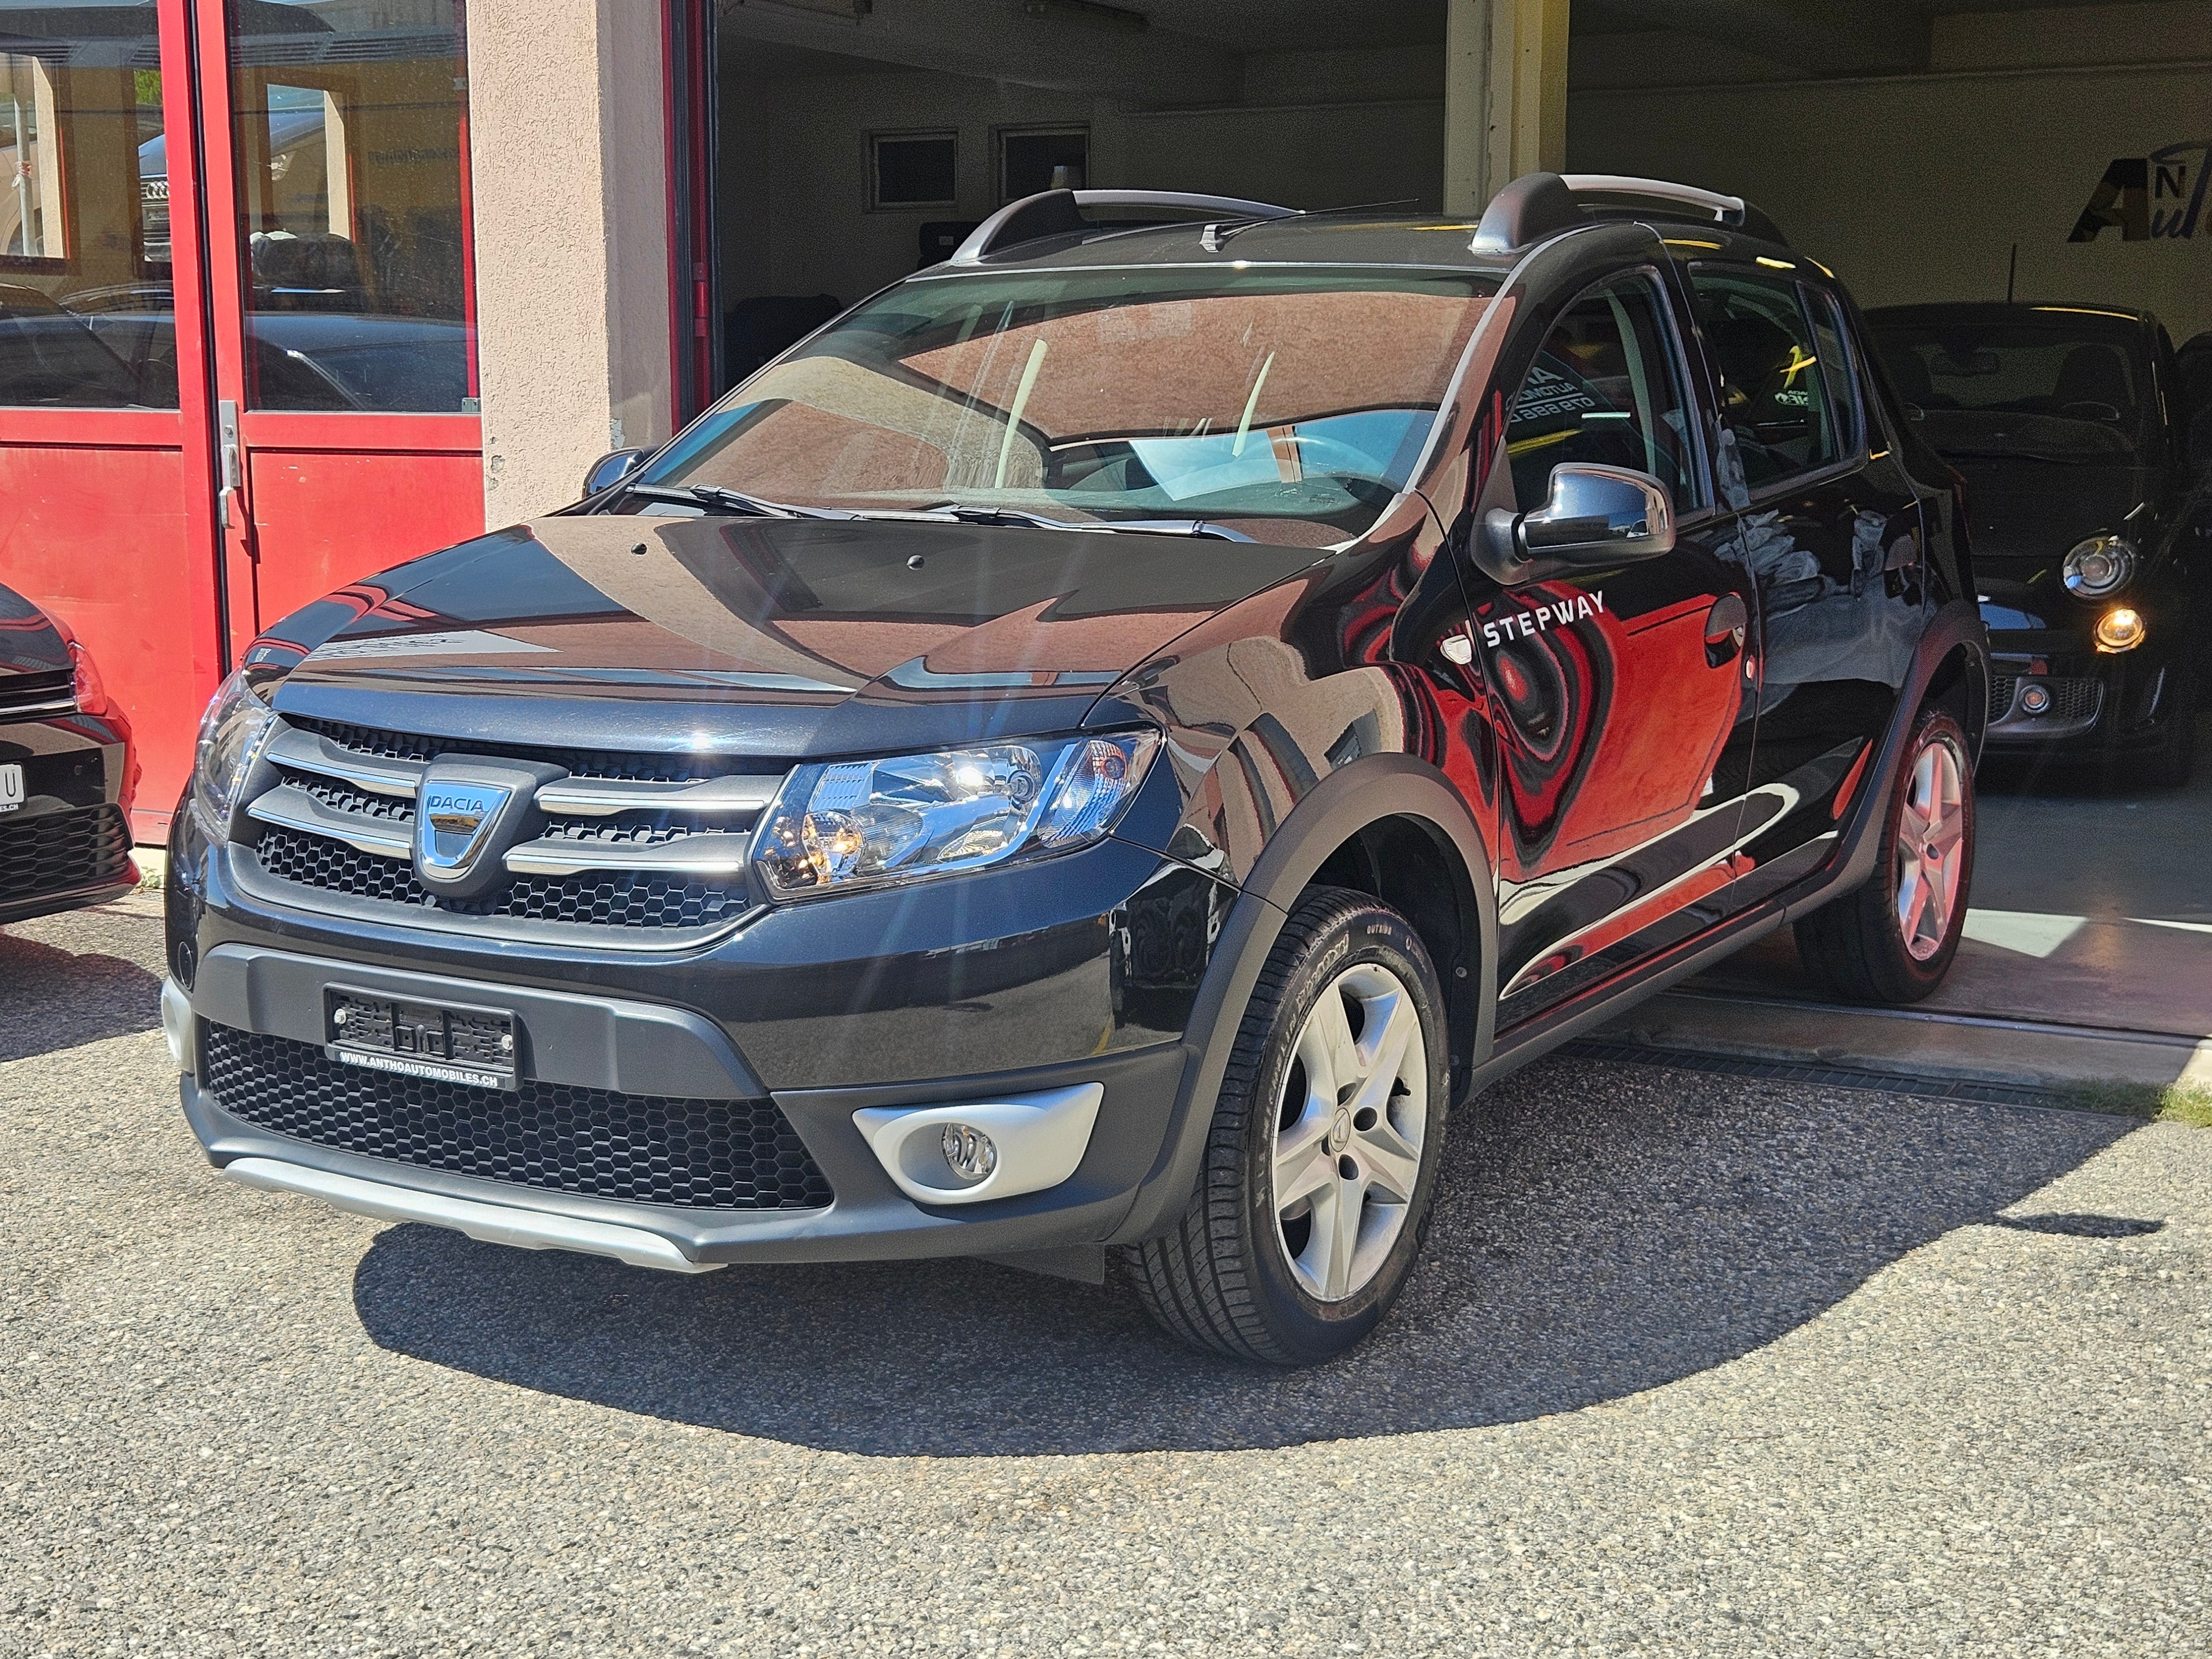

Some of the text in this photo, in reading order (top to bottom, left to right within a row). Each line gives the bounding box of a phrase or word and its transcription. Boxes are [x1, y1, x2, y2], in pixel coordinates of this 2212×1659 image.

[1483, 590, 1604, 648] STEPWAY
[5, 773, 17, 797] U
[430, 795, 484, 811] DACIA
[340, 1051, 498, 1087] WWW.ANTHOAUTOMOBILES.CH
